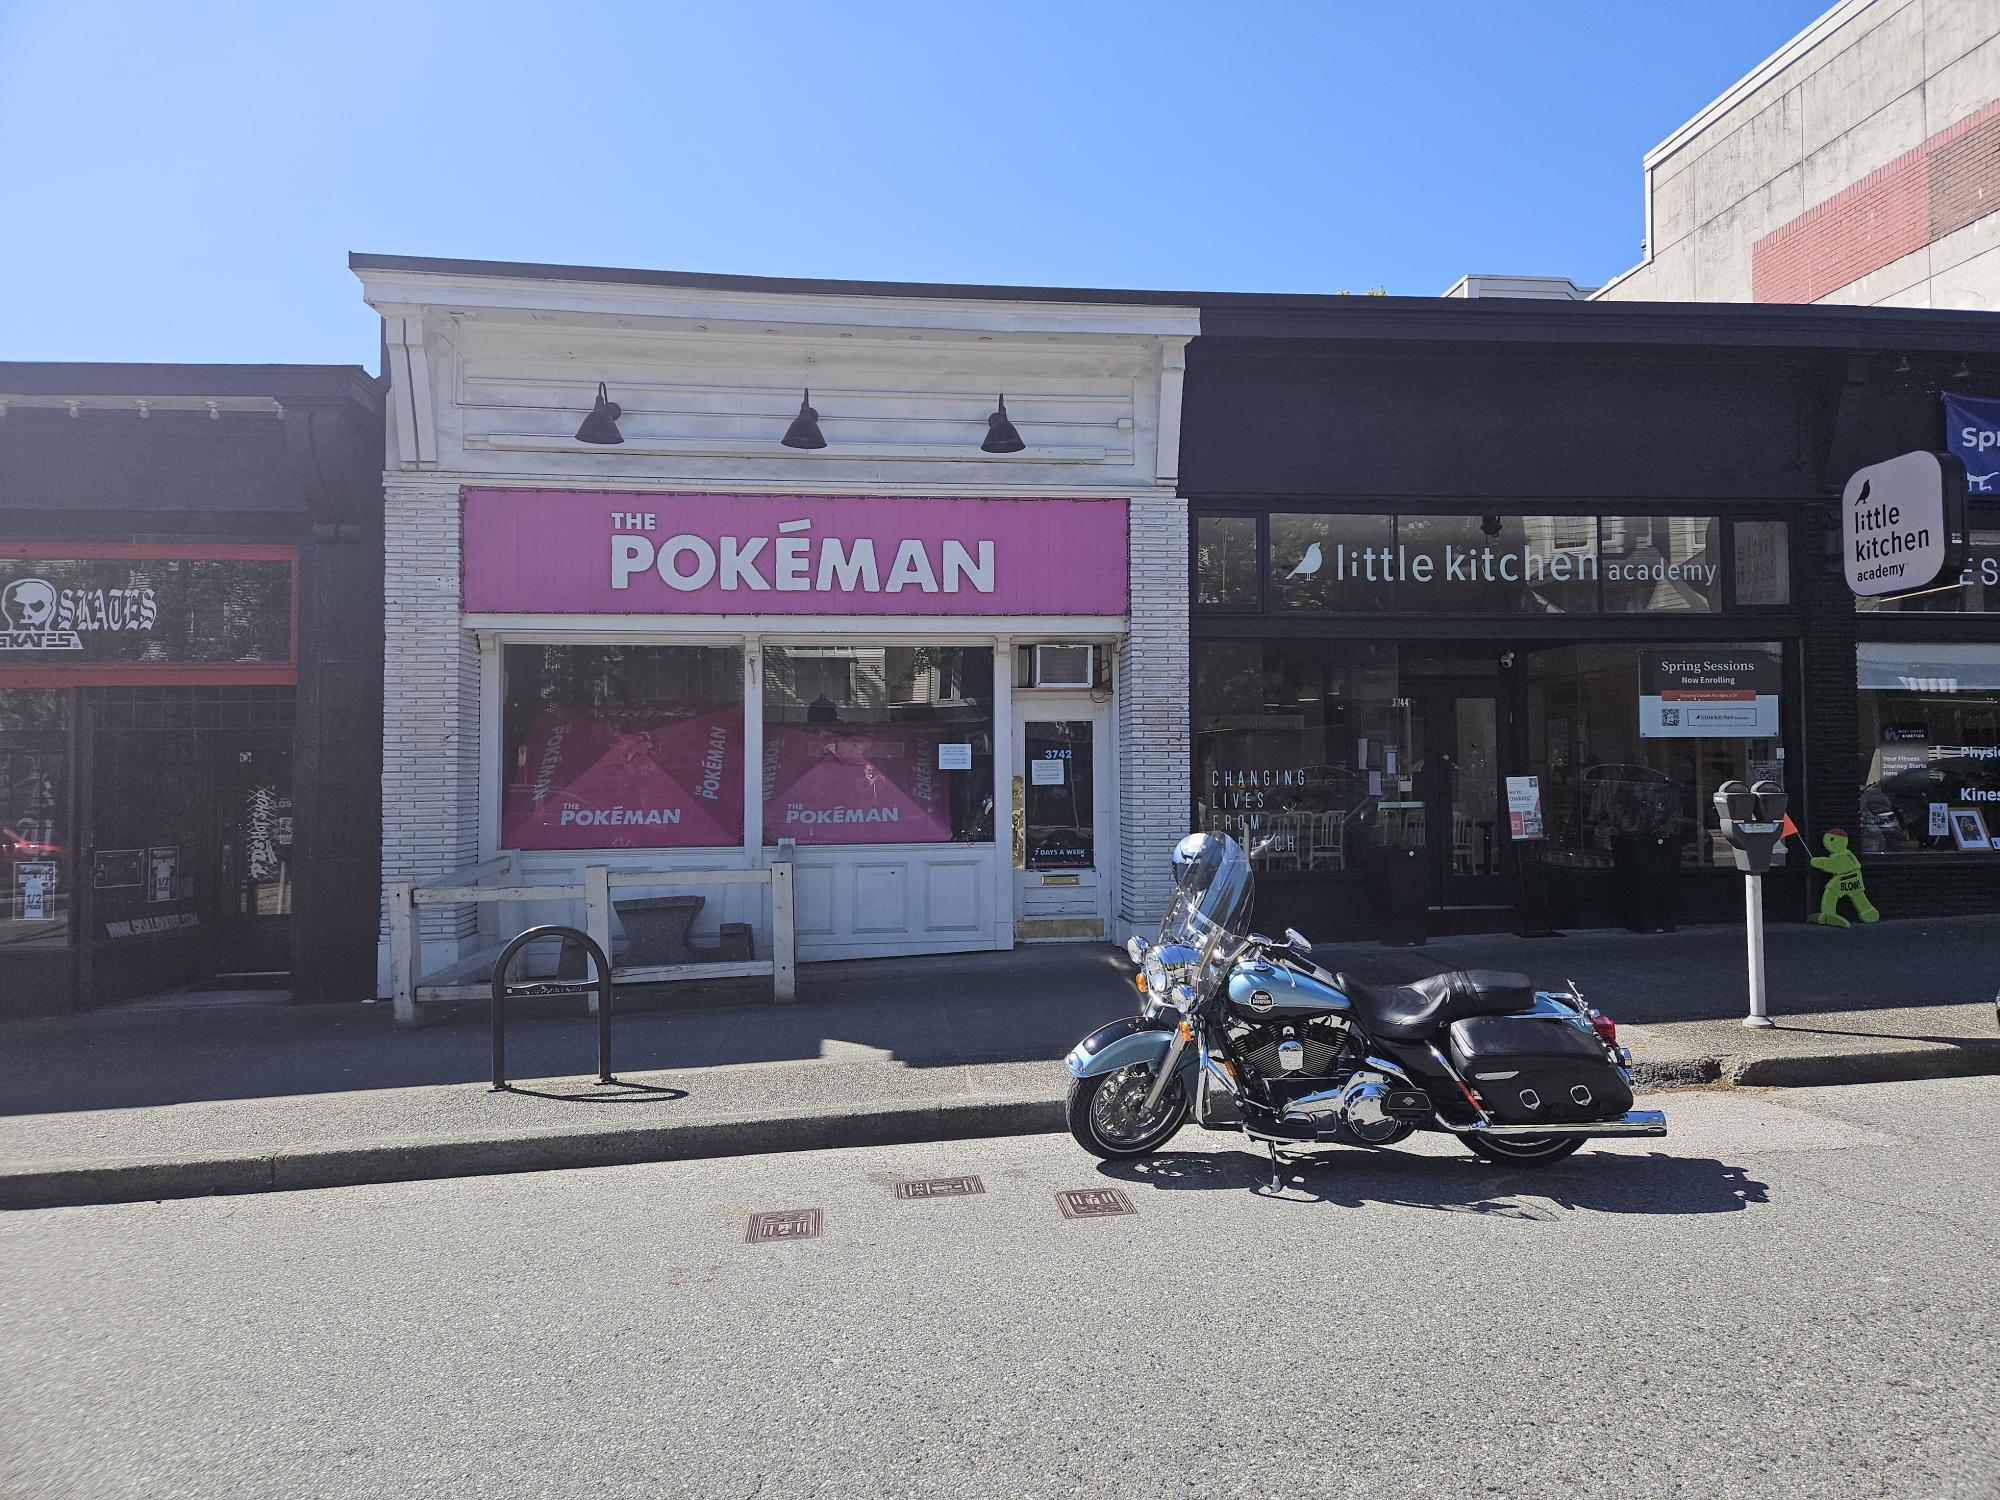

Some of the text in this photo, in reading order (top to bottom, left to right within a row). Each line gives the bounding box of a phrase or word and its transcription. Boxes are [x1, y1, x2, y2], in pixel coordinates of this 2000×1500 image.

[1961, 427, 2000, 452] Sp
[611, 512, 656, 530] THE
[1855, 503, 1900, 534] little
[1855, 529, 1929, 562] kitchen
[611, 518, 995, 593] POKÉMAN
[1338, 544, 1717, 587] little kitchen academy
[1857, 562, 1905, 582] academy
[58, 588, 157, 631] SKATES
[1661, 660, 1754, 674] Spring Sessions
[1681, 676, 1735, 686] Now Enrolling
[1045, 749, 1073, 759] 3742
[1212, 769, 1305, 787] CHANGING
[563, 802, 579, 810] THE
[1212, 792, 1264, 809] LIVES
[560, 805, 681, 826] POKÉMAN
[786, 805, 899, 824] POKÉMAN
[1213, 814, 1260, 831] FROM
[1840, 879, 1862, 891] SLOW!
